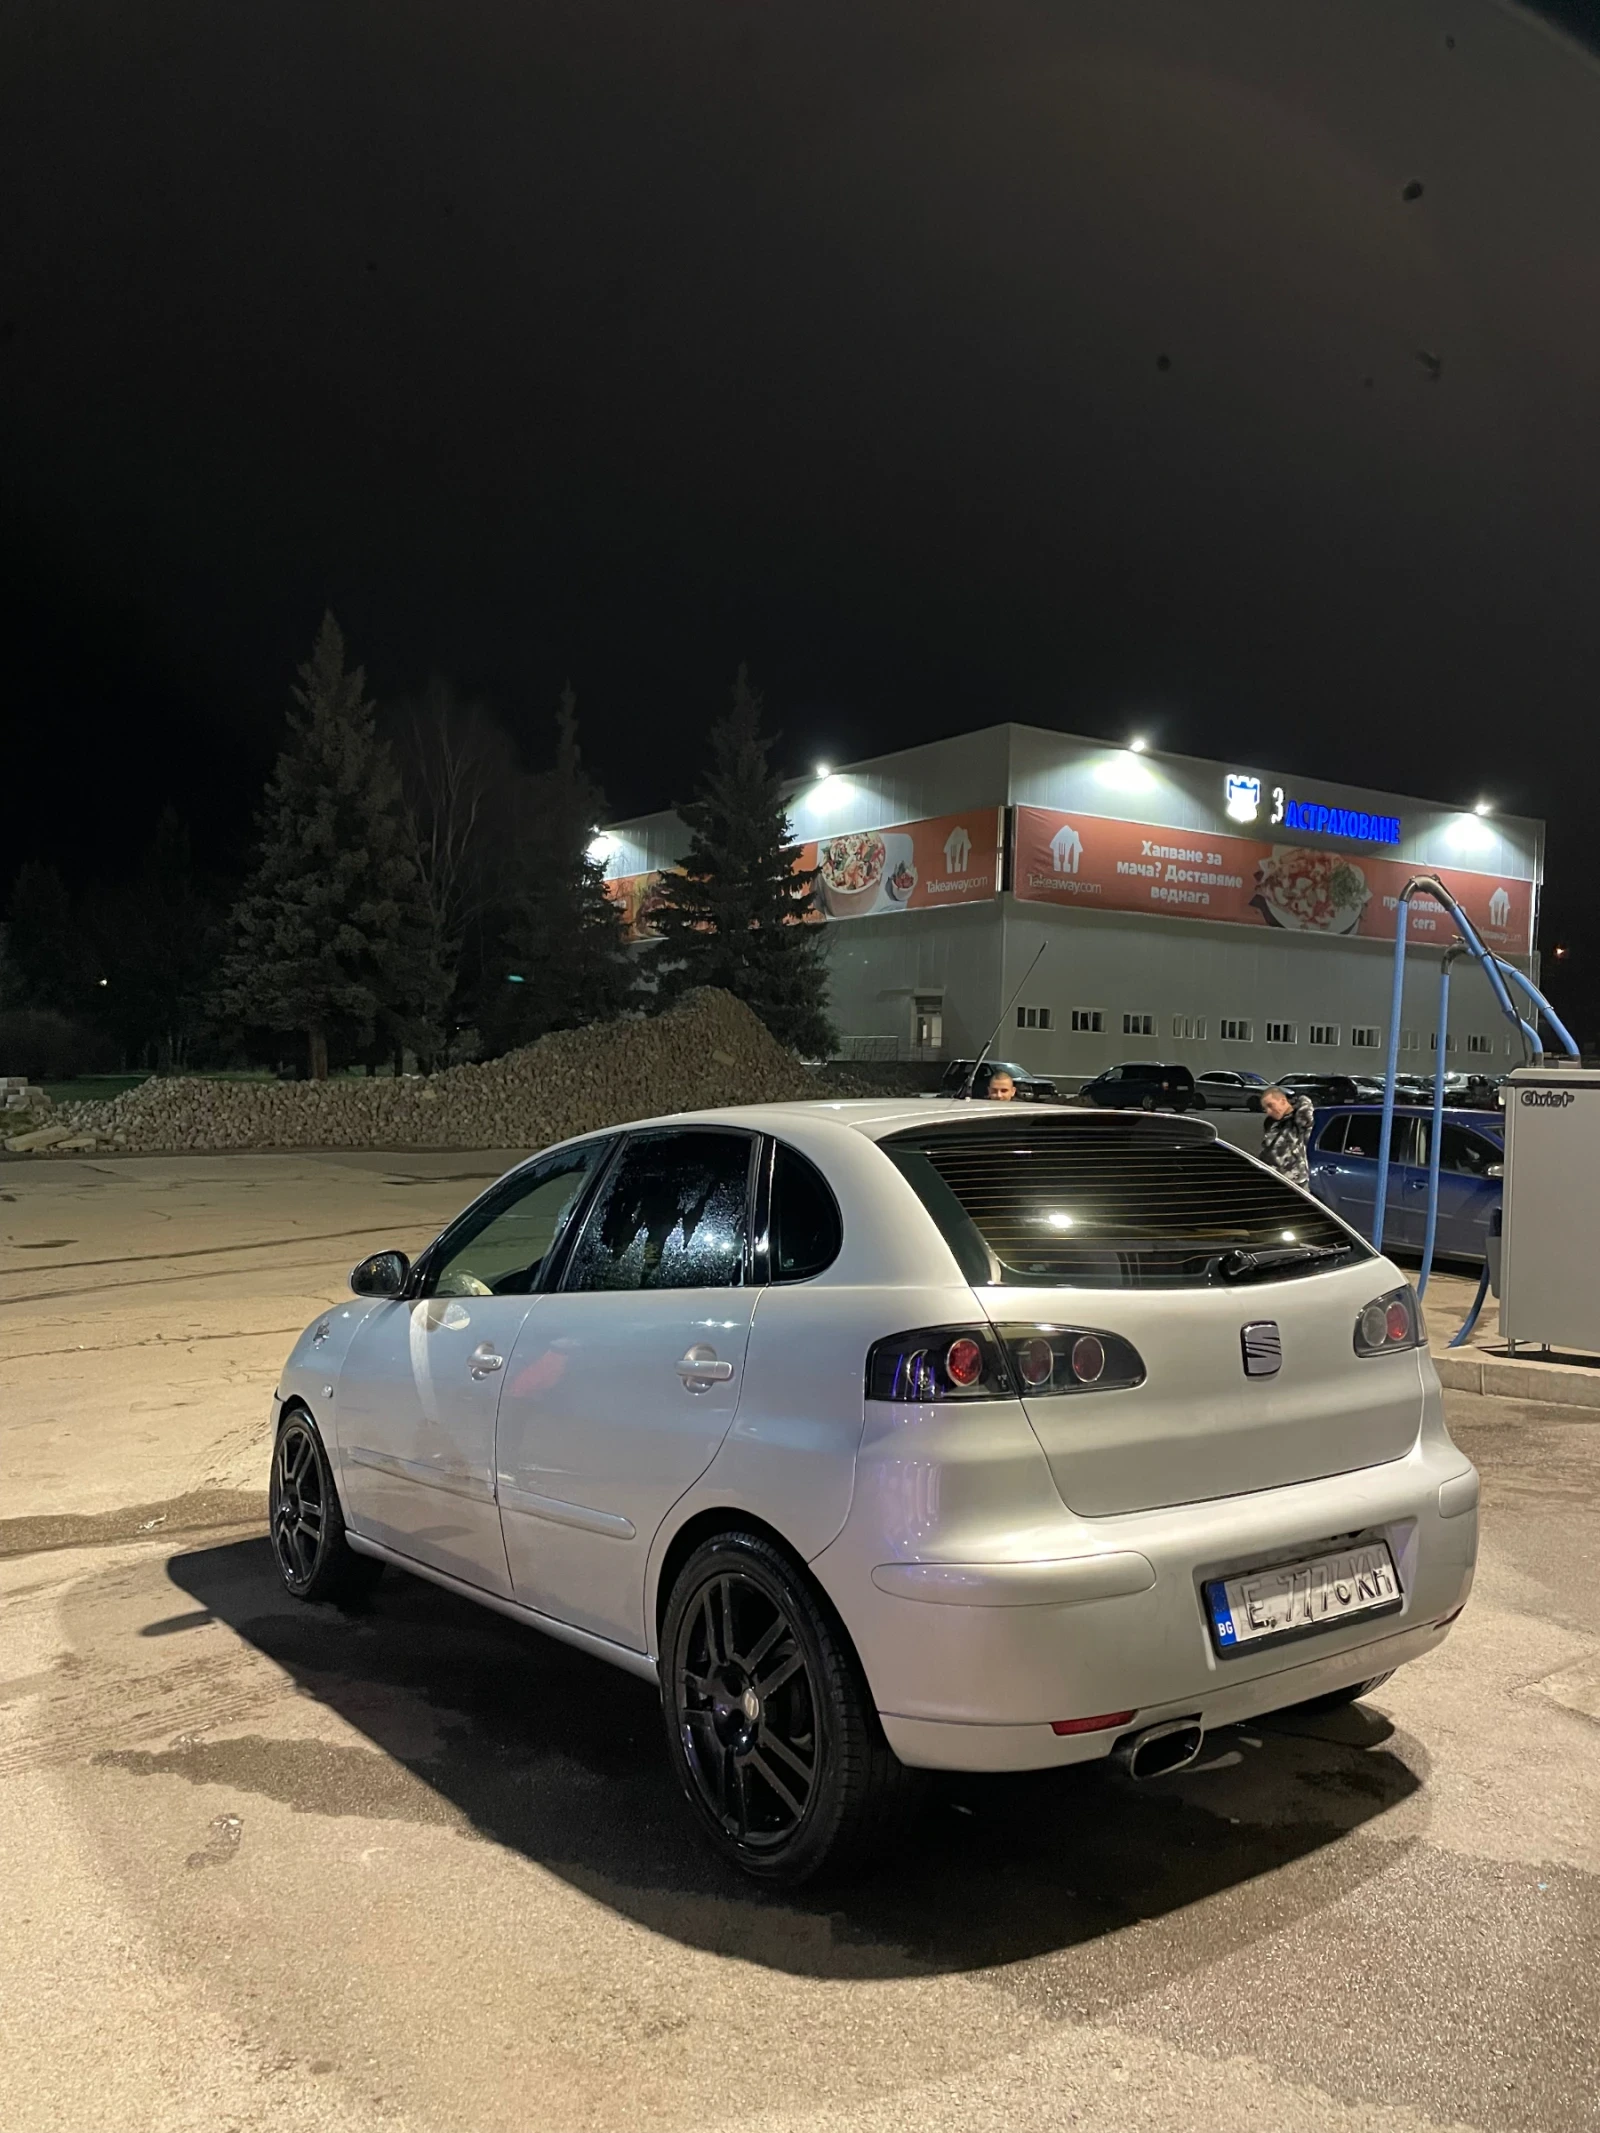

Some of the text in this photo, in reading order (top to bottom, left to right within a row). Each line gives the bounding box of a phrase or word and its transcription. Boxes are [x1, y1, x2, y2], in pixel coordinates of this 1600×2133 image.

[1141, 840, 1222, 866] Хапване за
[1026, 873, 1102, 896] Takeaway.com
[1116, 861, 1243, 888] мача? Доставяме
[926, 876, 988, 894] Takeaway.com
[1150, 885, 1210, 905] веднага
[1412, 918, 1437, 931] сега
[1218, 1622, 1234, 1637] BG
